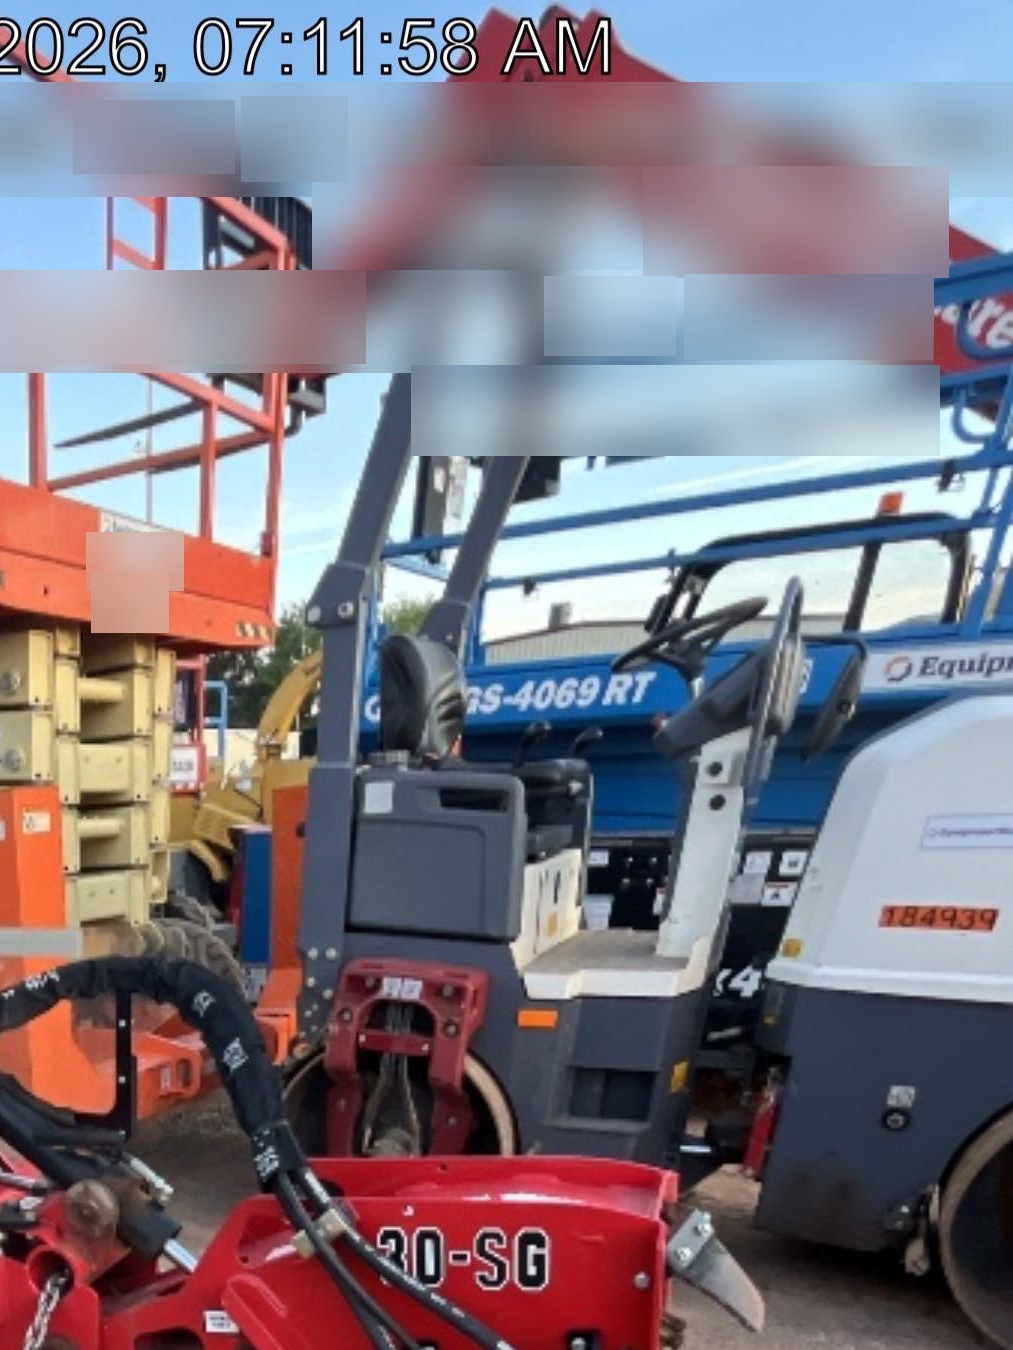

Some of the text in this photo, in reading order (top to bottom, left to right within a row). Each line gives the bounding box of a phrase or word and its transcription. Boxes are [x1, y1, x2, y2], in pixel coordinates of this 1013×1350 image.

[917, 654, 1013, 679] Equip
[602, 671, 657, 706] RT
[884, 905, 999, 931] 184939
[377, 1226, 550, 1290] 30-SG
